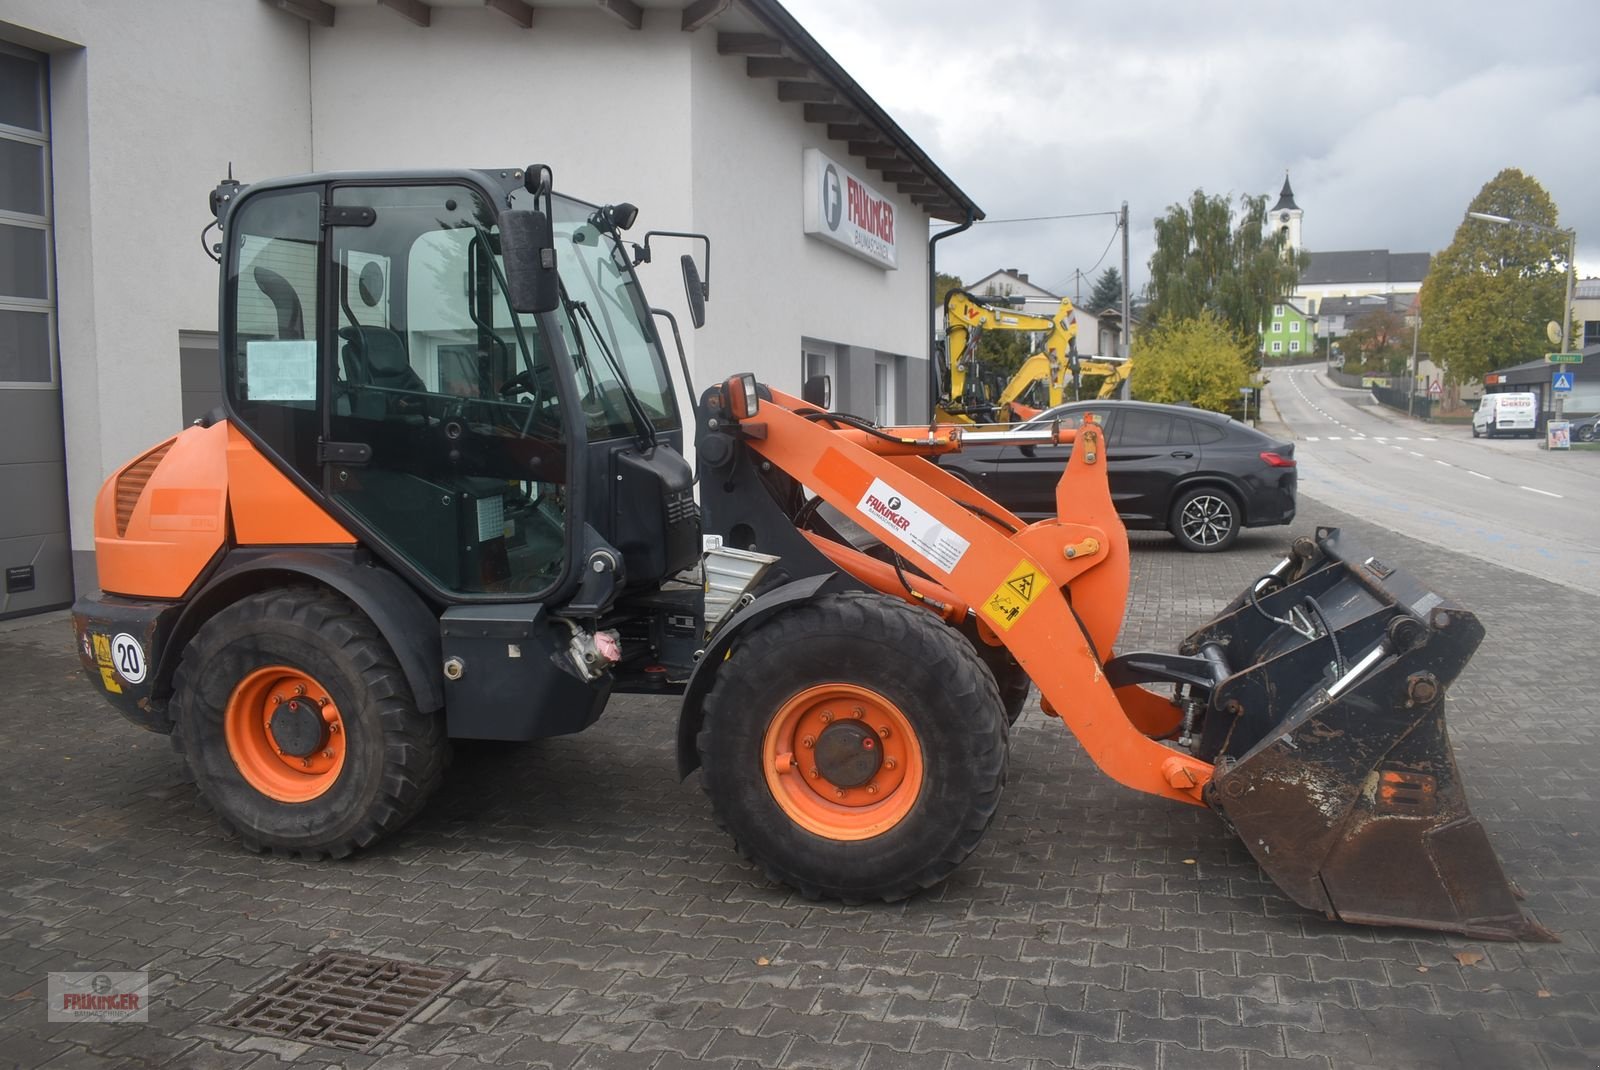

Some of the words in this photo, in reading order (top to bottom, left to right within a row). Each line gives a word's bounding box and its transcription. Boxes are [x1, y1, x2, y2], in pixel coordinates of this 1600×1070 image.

[846, 175, 894, 246] FALKINGER
[865, 494, 911, 532] FALKINGER
[117, 643, 140, 674] 20
